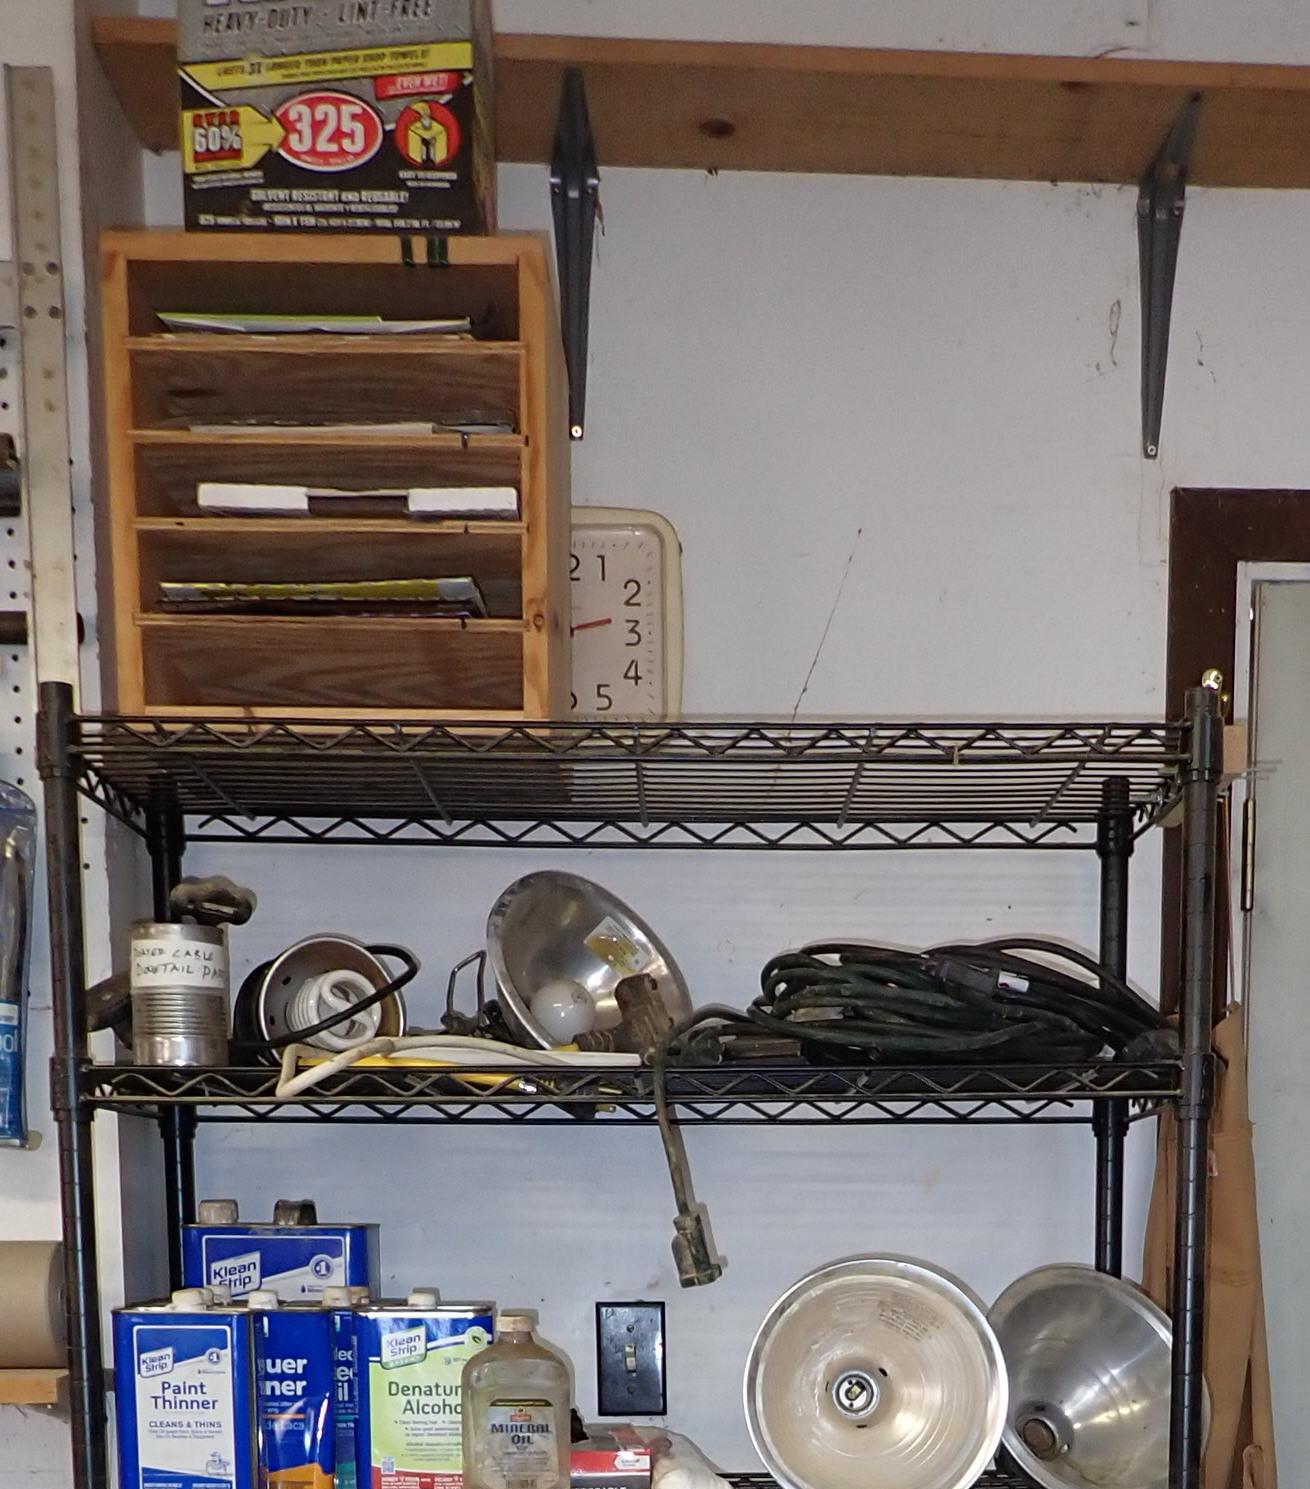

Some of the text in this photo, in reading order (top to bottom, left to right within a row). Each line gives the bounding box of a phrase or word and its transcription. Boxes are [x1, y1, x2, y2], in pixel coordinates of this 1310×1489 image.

[288, 104, 365, 153] 325
[194, 124, 241, 152] 60%
[597, 554, 606, 582] 1
[623, 579, 641, 606] 2
[625, 619, 642, 647] 3
[623, 659, 643, 686] 4
[596, 684, 613, 711] 5
[214, 1262, 256, 1280] Klean
[219, 1275, 252, 1289] Strip
[387, 1334, 420, 1348] Klean
[391, 1344, 417, 1357] Strip
[142, 1353, 171, 1366] Klean
[145, 1362, 168, 1373] Strip
[161, 1381, 207, 1395] Paint
[388, 1381, 462, 1396] Denatur
[150, 1395, 218, 1410] Thinner
[402, 1399, 462, 1415] Alcoho
[149, 1421, 184, 1429] CLEANS
[491, 1423, 552, 1433] MINERAL
[511, 1434, 534, 1445] OIL
